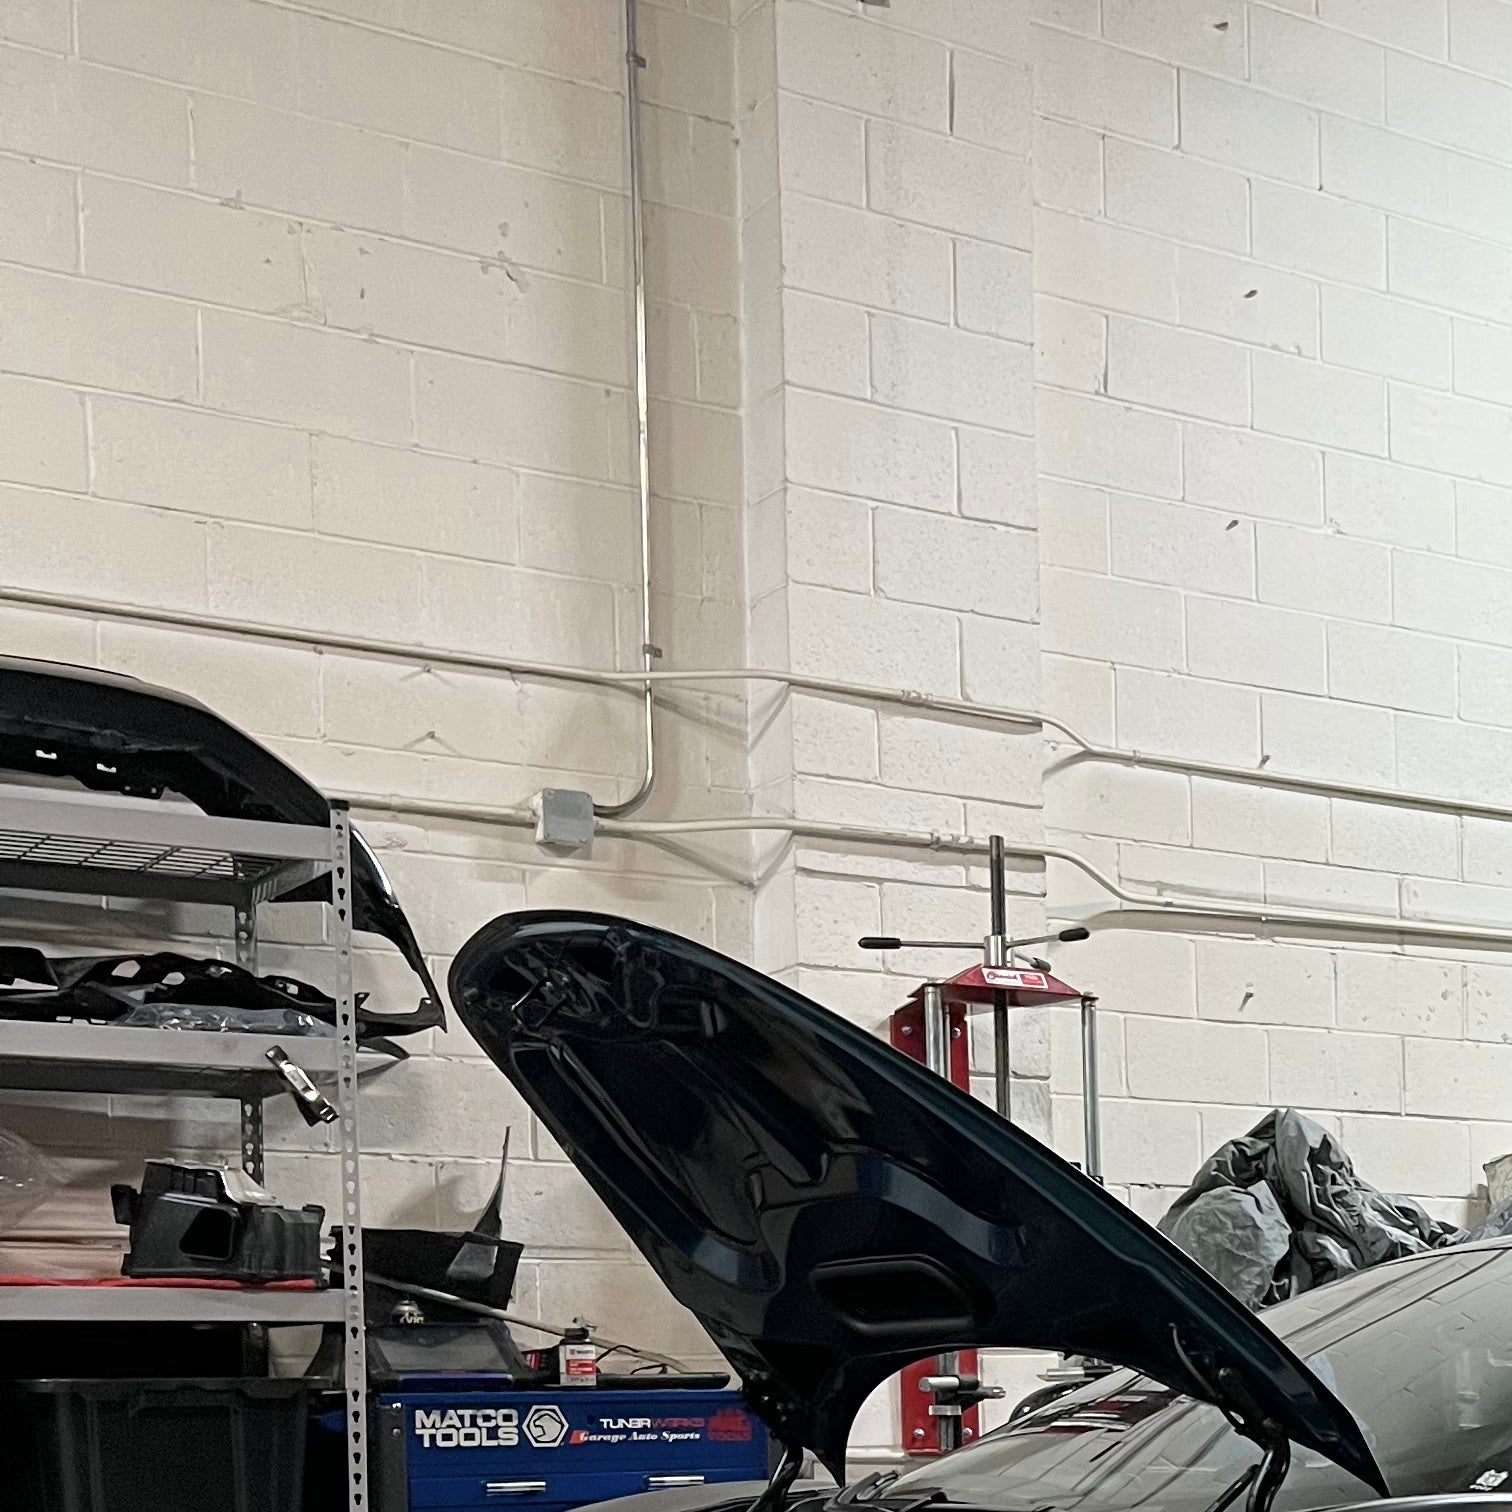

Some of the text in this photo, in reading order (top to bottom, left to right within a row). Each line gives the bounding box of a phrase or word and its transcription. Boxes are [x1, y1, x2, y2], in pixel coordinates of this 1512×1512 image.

[415, 1408, 519, 1429] MATCO
[415, 1427, 519, 1448] TOOLS
[579, 1431, 627, 1444] Garage
[628, 1431, 659, 1442] Auto
[660, 1430, 701, 1443] Sports
